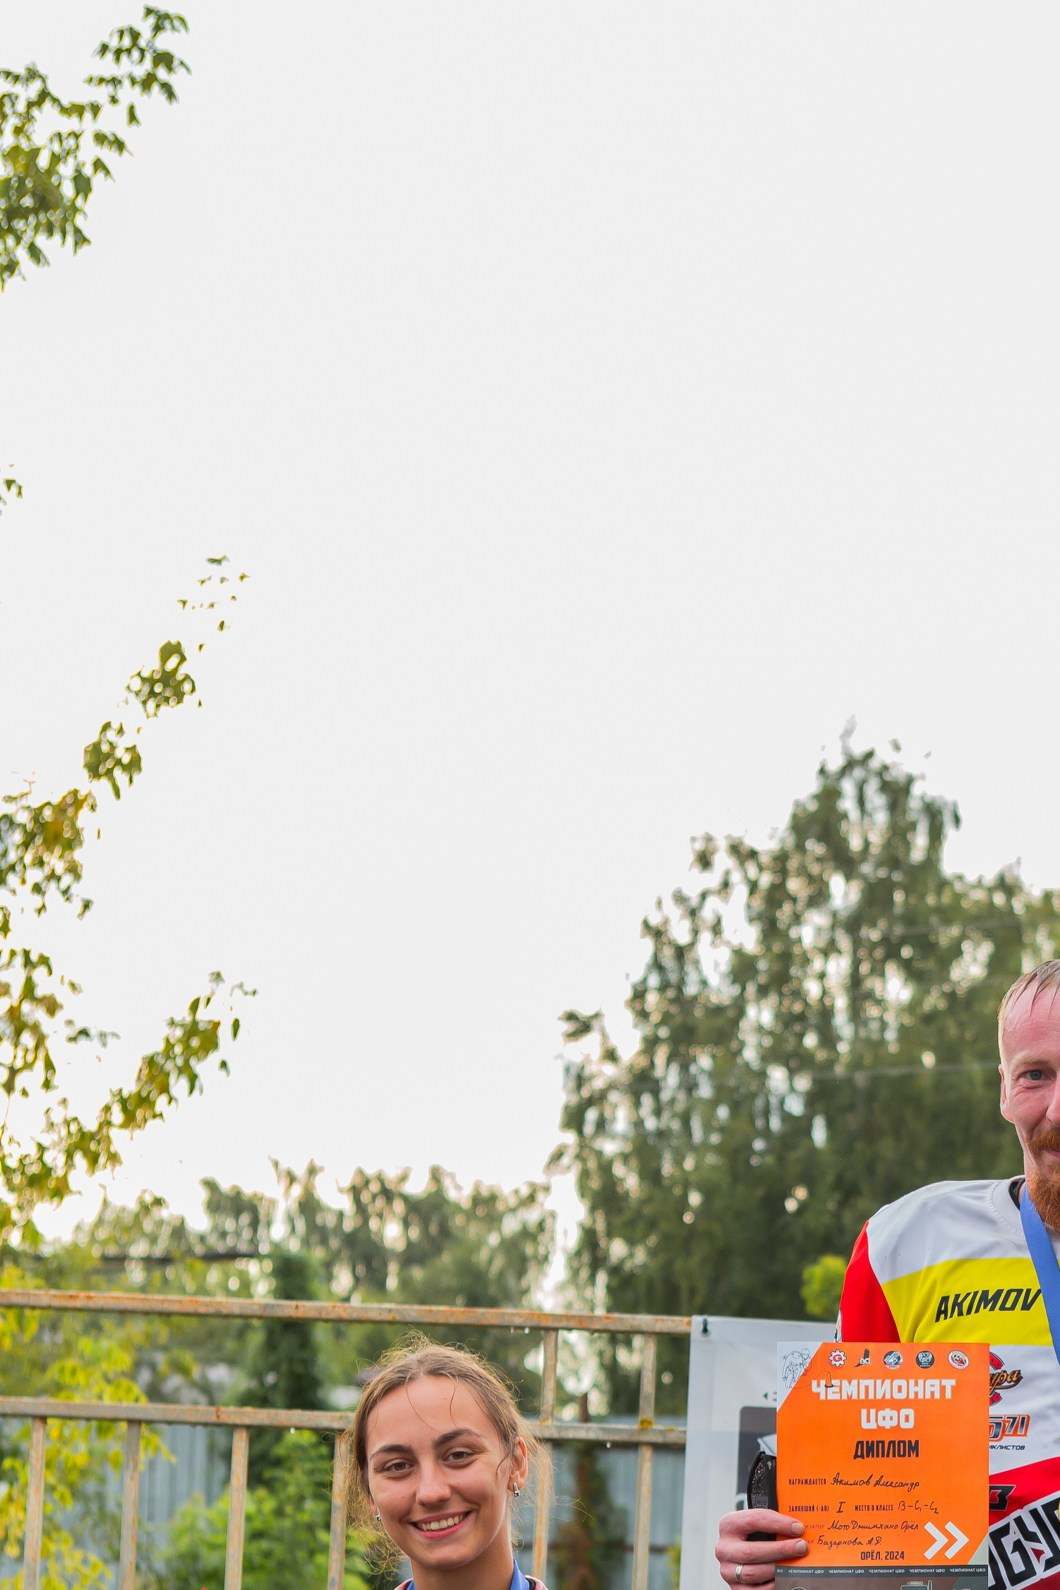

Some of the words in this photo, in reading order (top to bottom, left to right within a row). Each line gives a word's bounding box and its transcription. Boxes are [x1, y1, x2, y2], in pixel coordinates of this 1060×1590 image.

[934, 1288, 1042, 1323] AKIMOV
[811, 1378, 956, 1401] ЧЕМПИОНАТ
[860, 1407, 915, 1430] ЦФО
[853, 1439, 920, 1460] ДИПЛОМ
[884, 1550, 905, 1561] 2024
